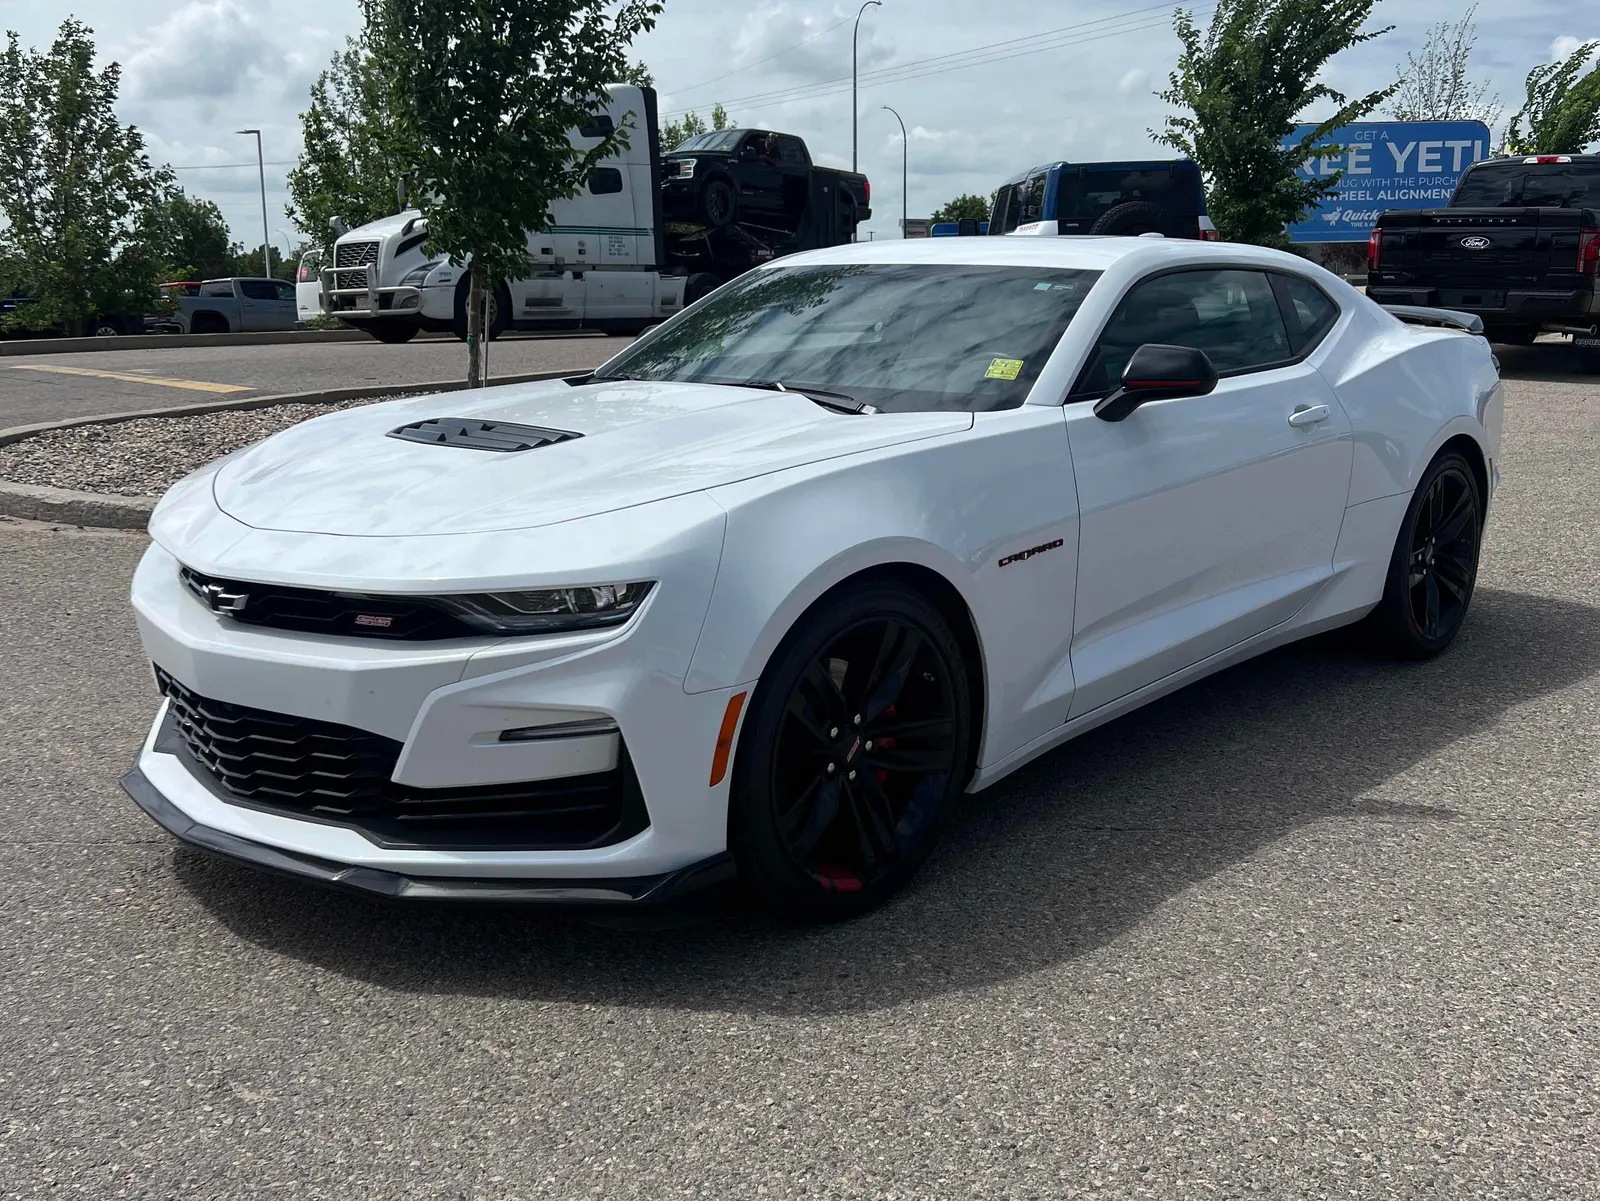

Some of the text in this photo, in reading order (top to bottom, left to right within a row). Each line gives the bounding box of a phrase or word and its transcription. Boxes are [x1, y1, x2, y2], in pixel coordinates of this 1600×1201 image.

[1354, 131, 1389, 141] GET A
[1386, 140, 1483, 174] YETI
[1360, 178, 1391, 188] WITH
[1393, 177, 1416, 187] THE
[1341, 209, 1380, 222] Quick
